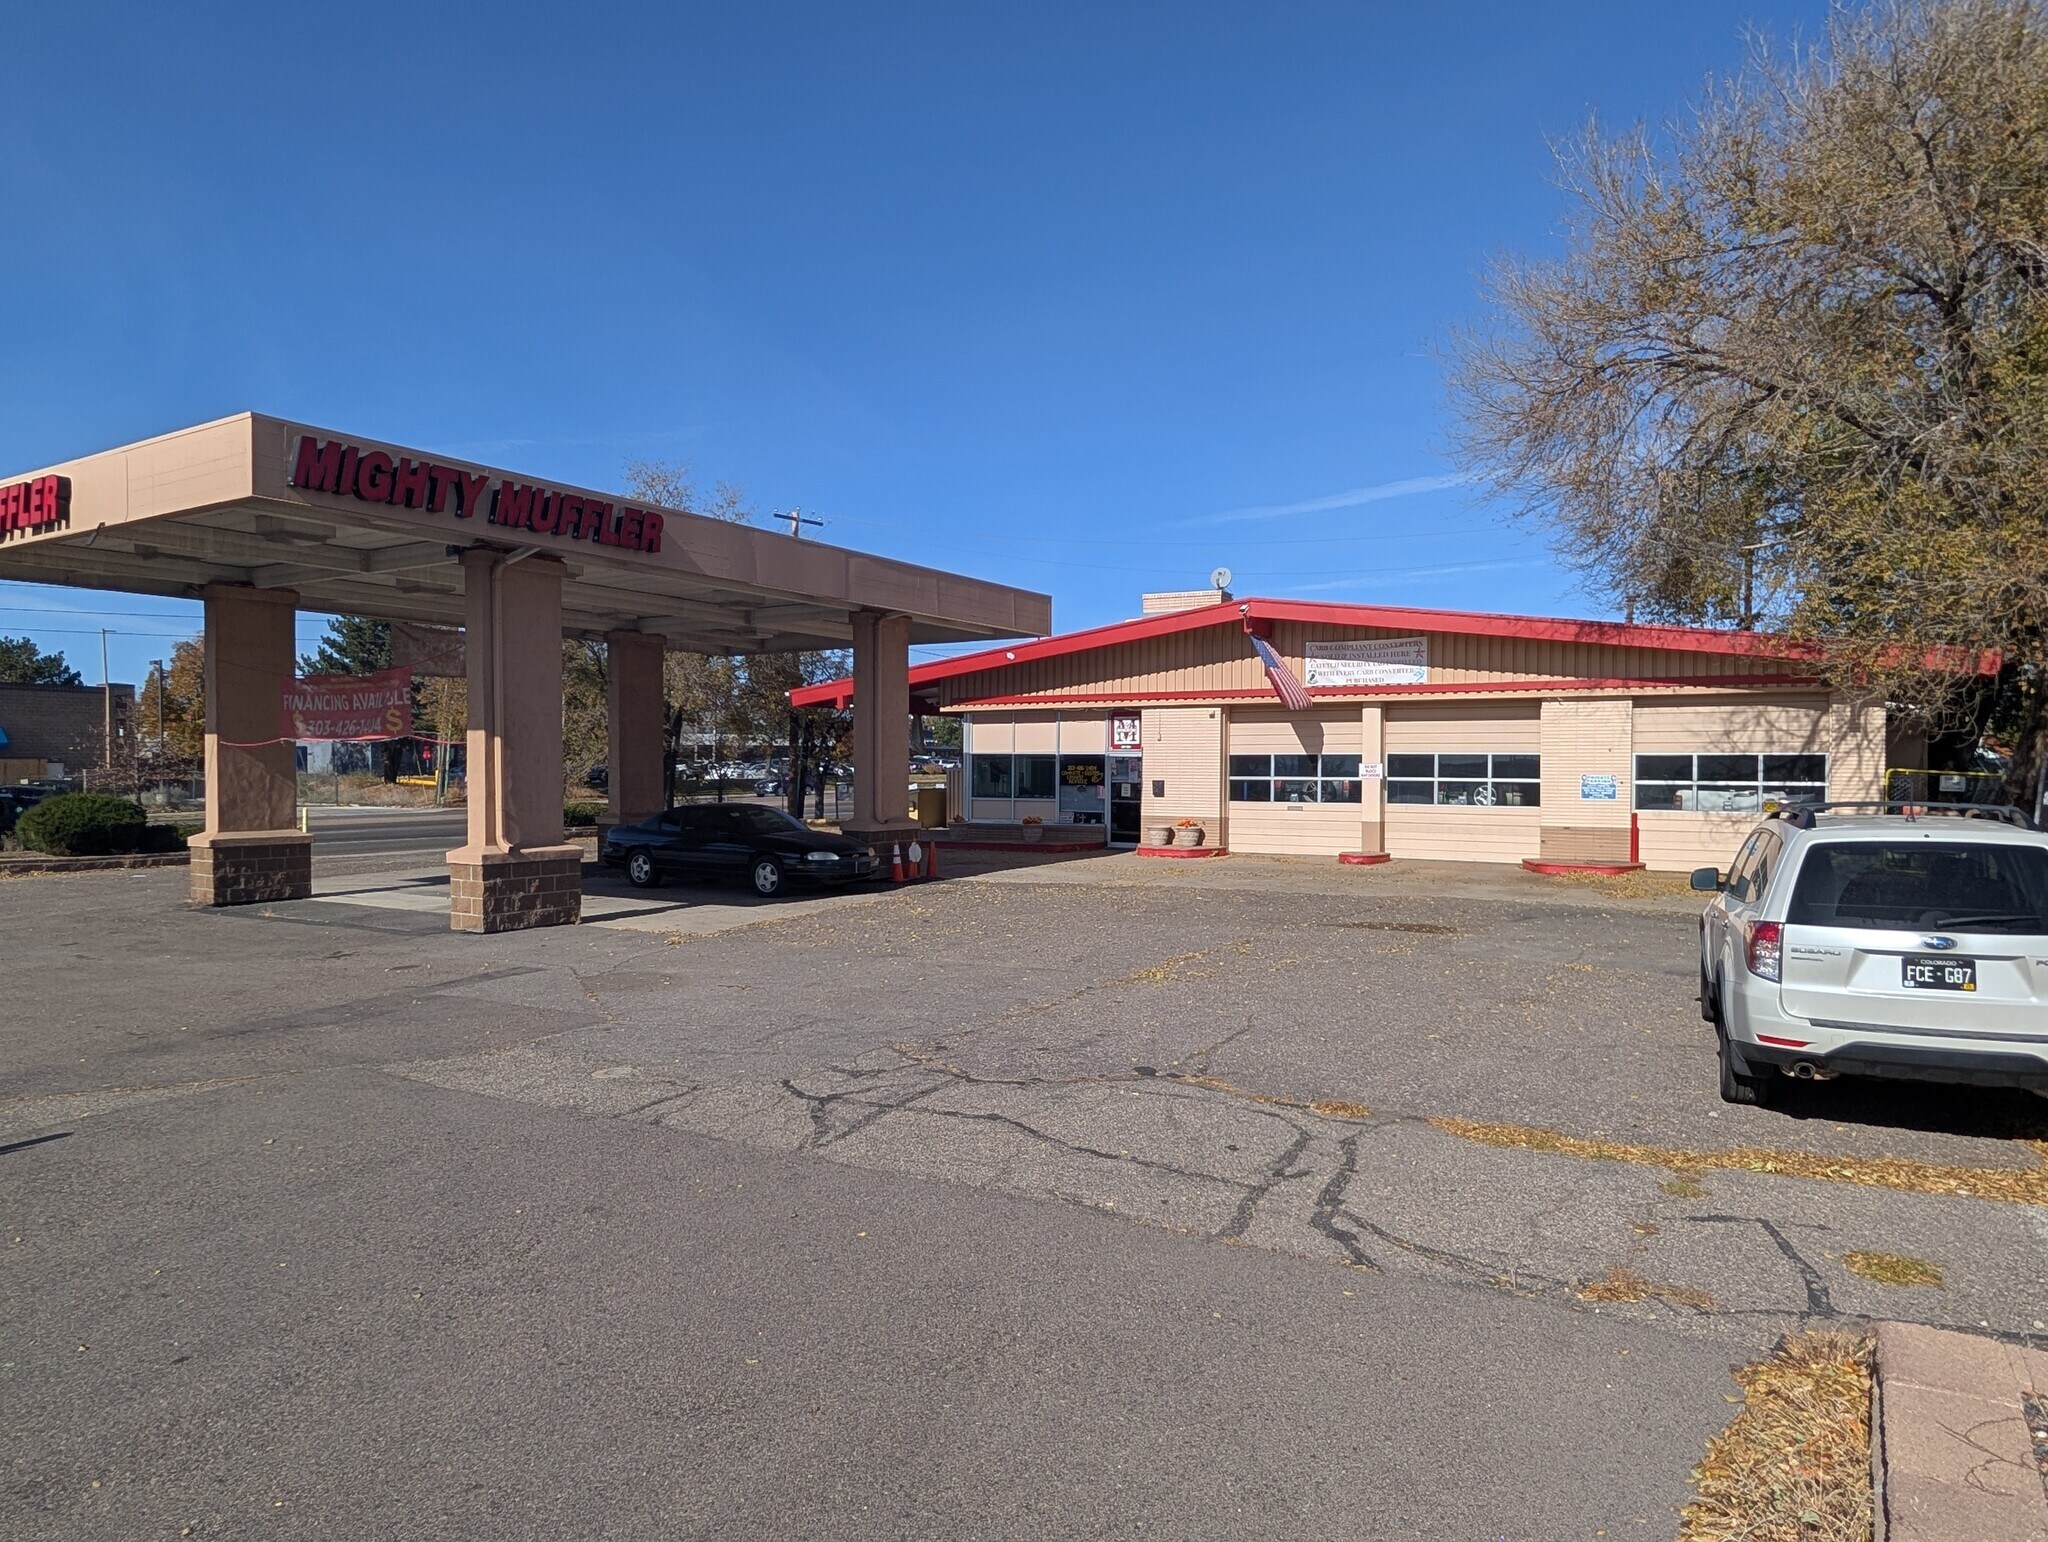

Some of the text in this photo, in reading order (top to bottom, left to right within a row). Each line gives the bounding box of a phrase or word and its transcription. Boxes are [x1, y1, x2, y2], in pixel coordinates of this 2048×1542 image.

[288, 435, 665, 553] MIGHTY MUFFLER
[1330, 642, 1372, 651] COMPLIANT
[1373, 640, 1424, 650] CONVERTERS
[1349, 651, 1389, 659] INSTALLED
[1390, 650, 1411, 658] HERE
[1345, 676, 1385, 684] PURCHASED
[283, 693, 349, 710] FINANCING
[1790, 947, 1842, 957] SUBARU
[1920, 958, 1958, 967] COLORADO
[1906, 965, 1973, 984] FCE G87
